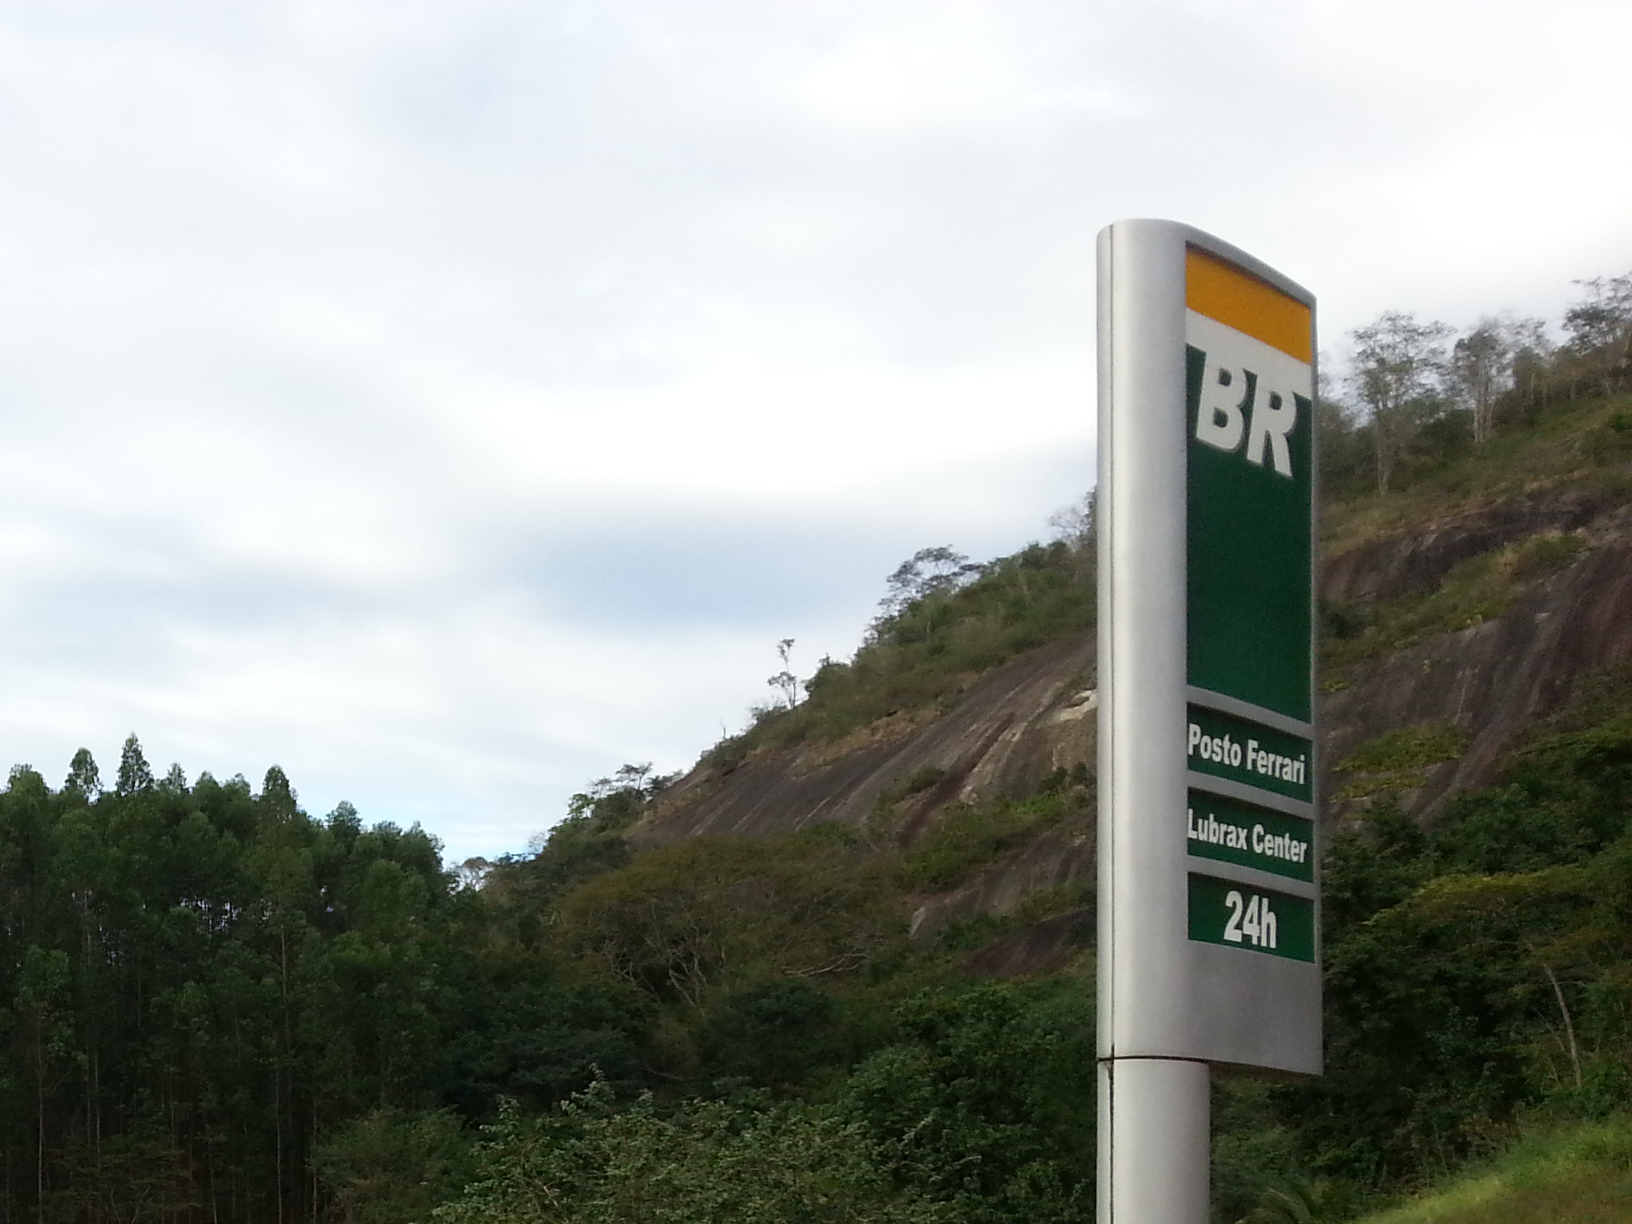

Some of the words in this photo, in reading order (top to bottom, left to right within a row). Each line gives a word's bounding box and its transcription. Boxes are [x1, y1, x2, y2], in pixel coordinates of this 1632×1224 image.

[1196, 352, 1297, 478] BR
[1188, 723, 1242, 767] Posto
[1246, 739, 1306, 785] Ferrari
[1187, 808, 1248, 851] Lubrax
[1252, 823, 1308, 864] Center
[1223, 890, 1278, 949] 24h
